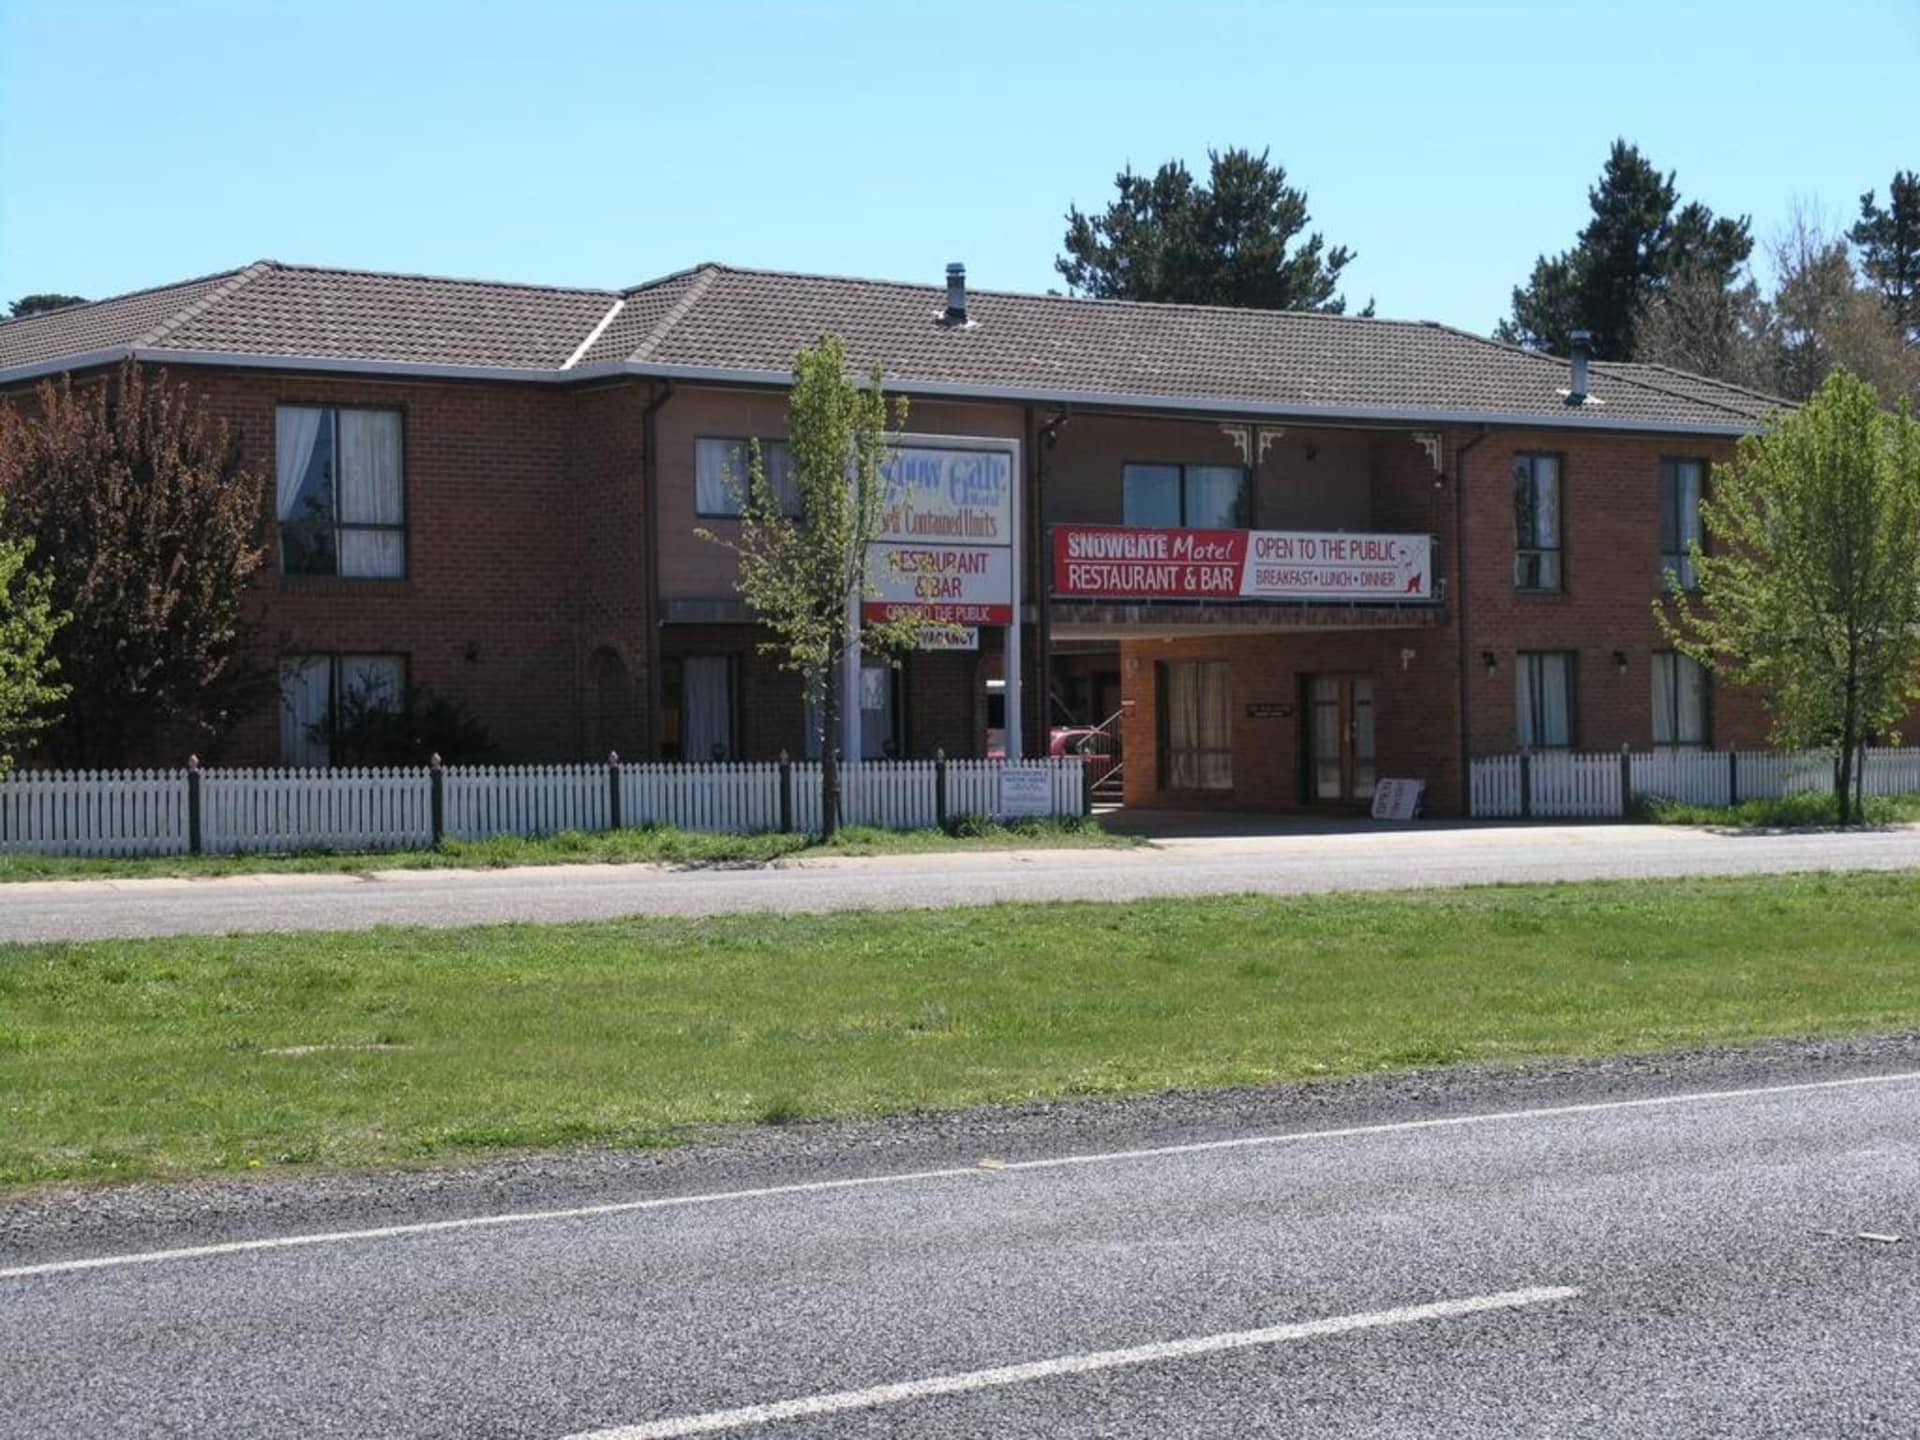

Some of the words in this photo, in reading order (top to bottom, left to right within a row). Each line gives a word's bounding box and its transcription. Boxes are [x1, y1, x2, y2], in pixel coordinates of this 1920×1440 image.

[904, 508, 962, 536] Contained
[964, 508, 998, 537] Units
[1068, 532, 1169, 559] SNOWGATE
[1172, 535, 1234, 562] Motel
[1255, 537, 1293, 559] OPEN
[1297, 539, 1317, 560] TO
[1320, 540, 1346, 560] THE
[1350, 540, 1397, 561] PUBLIC
[931, 577, 962, 598] BAR
[1068, 564, 1180, 590] RESTAURANT
[1184, 566, 1197, 591] &
[1201, 566, 1233, 591] BAR
[1256, 570, 1314, 587] BREAKFAST
[1320, 572, 1353, 588] LUNCH
[1360, 572, 1396, 588] DINNER
[956, 606, 991, 621] PUBLIC
